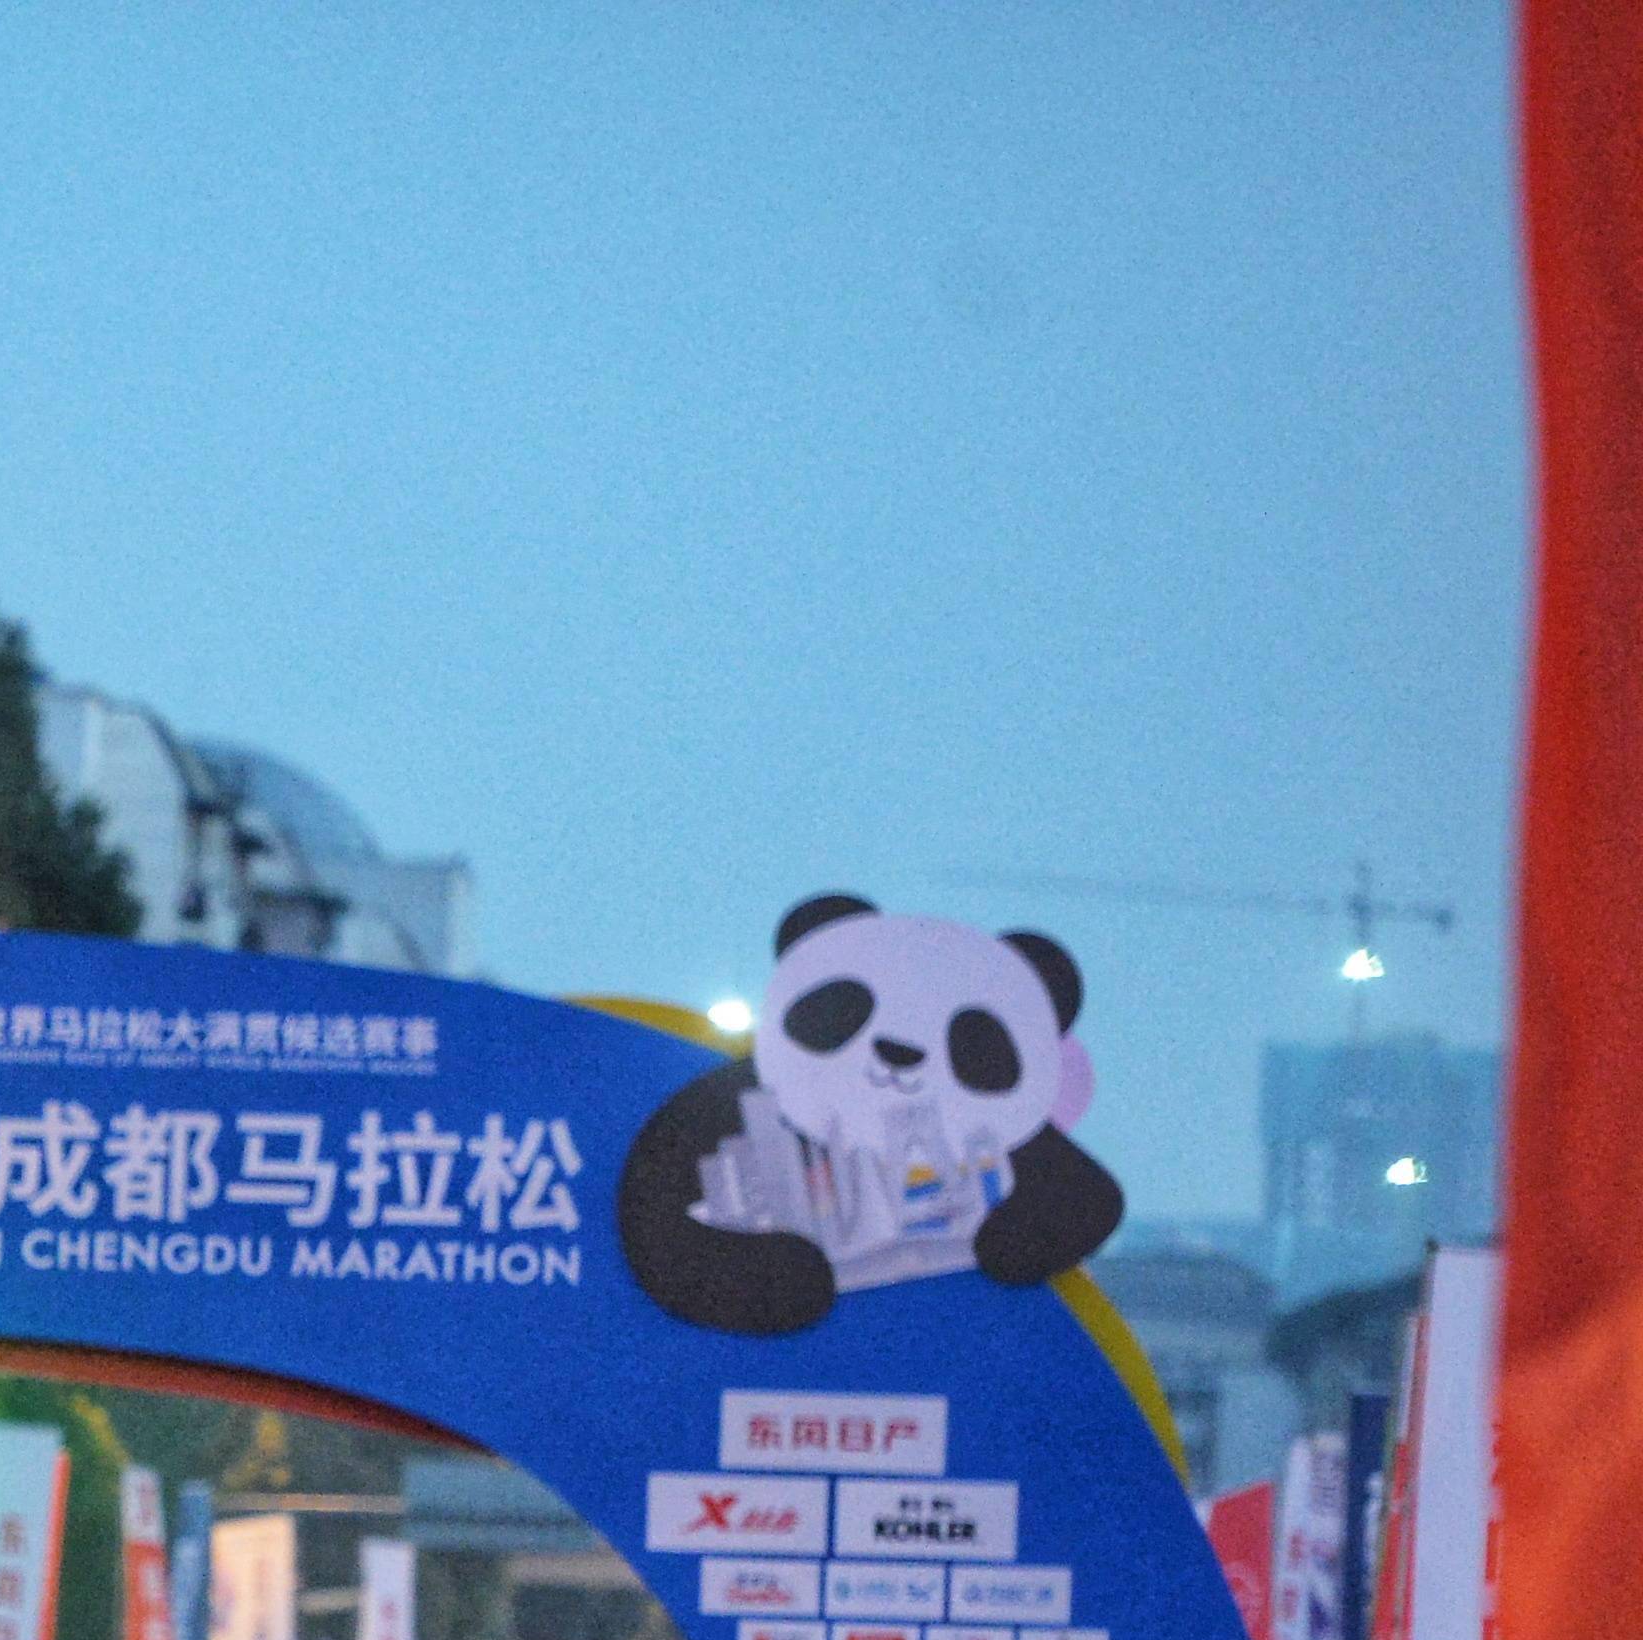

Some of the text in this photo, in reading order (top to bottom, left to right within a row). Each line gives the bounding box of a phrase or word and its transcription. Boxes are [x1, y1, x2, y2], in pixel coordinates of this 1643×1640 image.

[21, 1229, 274, 1279] CHENGDU
[291, 1243, 583, 1288] MARATHON
[747, 1413, 920, 1454] 东风日产
[872, 1517, 979, 1544] KOHLER
